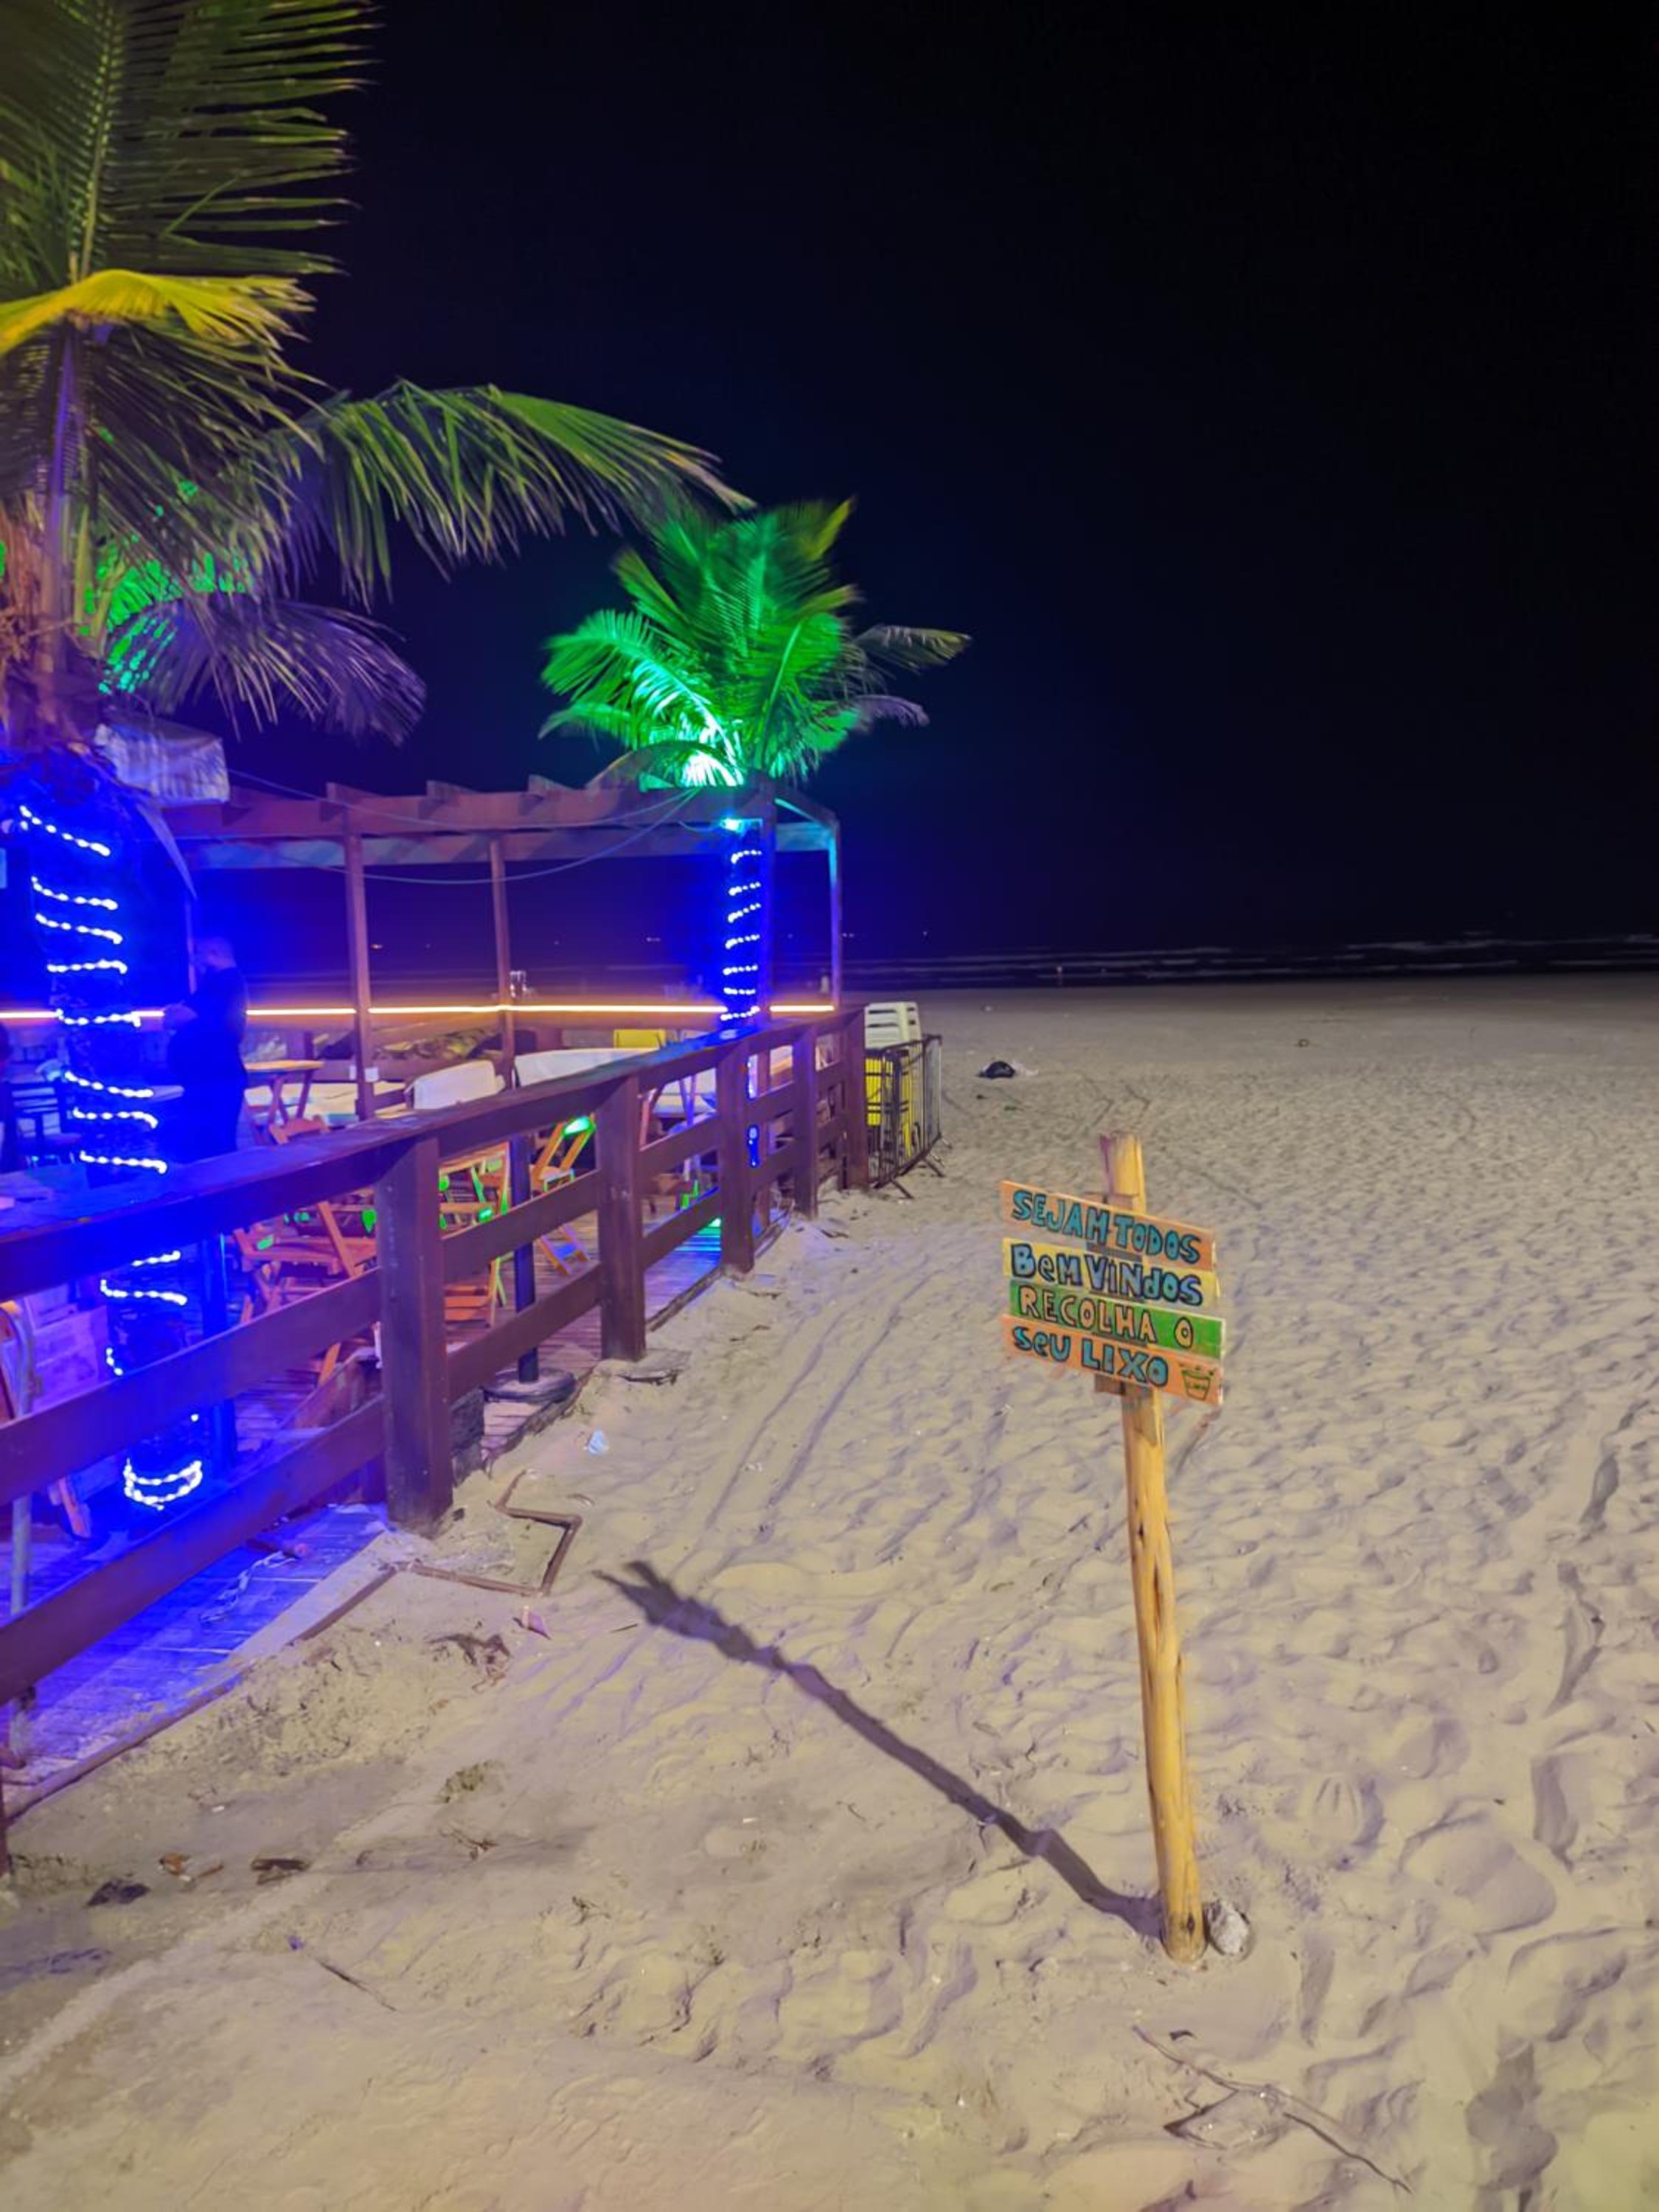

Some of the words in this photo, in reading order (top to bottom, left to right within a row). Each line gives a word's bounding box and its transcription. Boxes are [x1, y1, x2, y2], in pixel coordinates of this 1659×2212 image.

[1012, 1189, 1110, 1245] SEJAM
[1114, 1215, 1201, 1263] TODOS
[1018, 1286, 1158, 1343] RECOLHA
[1175, 1317, 1194, 1349] O
[1081, 1338, 1169, 1386] LIXO
